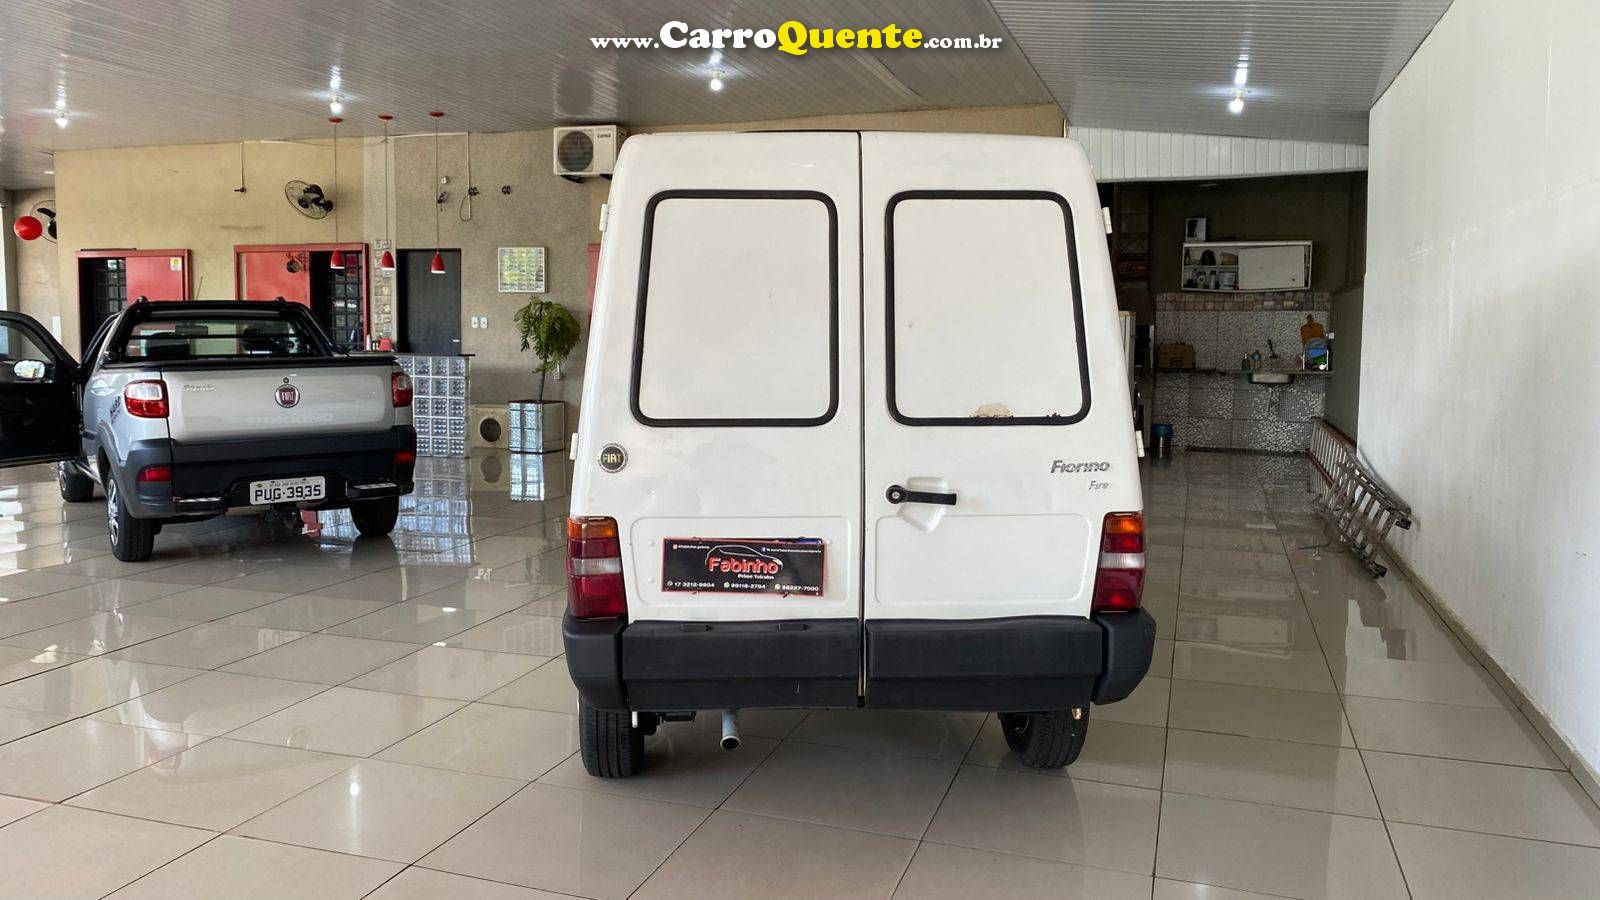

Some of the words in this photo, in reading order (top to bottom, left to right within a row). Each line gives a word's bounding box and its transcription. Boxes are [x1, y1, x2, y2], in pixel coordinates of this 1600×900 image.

[281, 391, 295, 401] FIAT
[602, 453, 622, 463] FIAT
[1050, 460, 1110, 473] Fiorino
[1089, 480, 1109, 490] Fire
[708, 556, 779, 574] Fabinho
